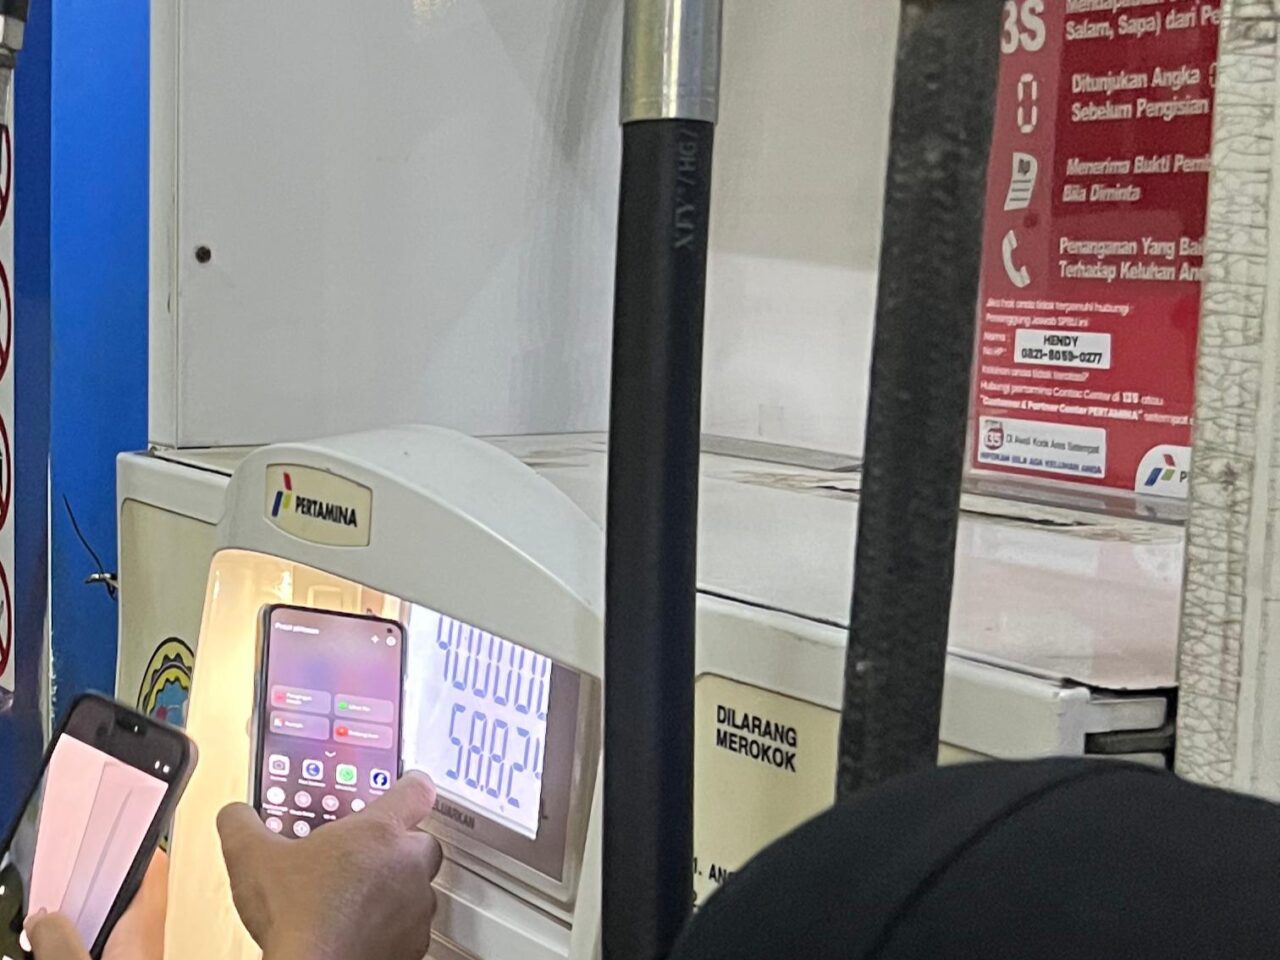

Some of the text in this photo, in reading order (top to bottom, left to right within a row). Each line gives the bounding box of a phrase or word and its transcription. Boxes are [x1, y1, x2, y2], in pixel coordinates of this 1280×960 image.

[1001, 0, 1047, 54] 3S
[1066, 4, 1219, 41] Salam, Sapa) dari Pe
[1072, 71, 1147, 95] Ditunjukan
[1151, 65, 1200, 90] Angka
[1072, 96, 1209, 122] Sebelum Pengisian
[1066, 157, 1131, 176] Menerima
[1133, 154, 1170, 174] Bukti
[1062, 183, 1141, 202] Bila Diminta
[1059, 236, 1204, 259] Penanganan Yang Bai
[1059, 260, 1203, 283] Terhadap Keluhan An
[1043, 335, 1078, 347] HENDY
[295, 495, 358, 528] PERTAMINA
[716, 705, 797, 748] DILARANG
[716, 729, 796, 773] MEROKOK
[709, 863, 728, 884] AN
